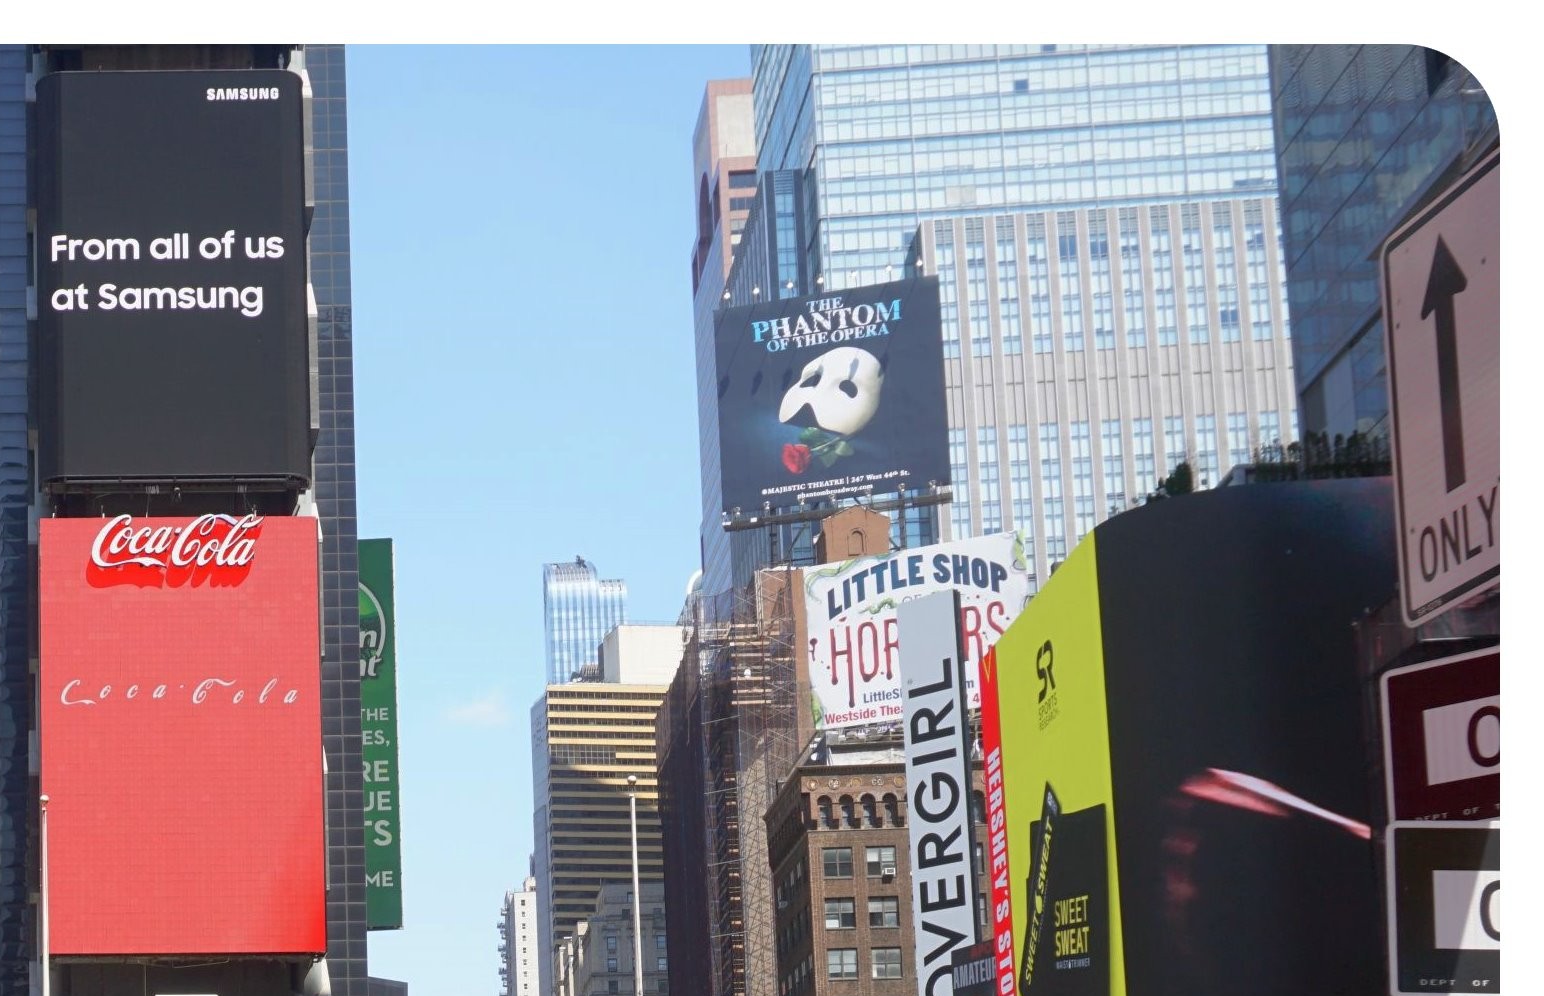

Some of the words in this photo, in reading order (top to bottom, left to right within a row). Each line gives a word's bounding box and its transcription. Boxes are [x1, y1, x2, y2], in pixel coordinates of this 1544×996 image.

[206, 87, 279, 101] SAMSUNG
[50, 234, 141, 262] From
[149, 232, 189, 260] all
[198, 229, 235, 260] of
[244, 235, 285, 259] us
[50, 282, 89, 311] at
[97, 282, 264, 318] Samsung
[806, 296, 844, 313] THE
[750, 299, 903, 343] PHANTOM
[766, 337, 791, 353] OF
[792, 331, 829, 349] THE
[830, 322, 890, 343] OPERA
[796, 483, 874, 500] phantombroadway.com
[807, 478, 845, 489] THEATRE
[90, 513, 265, 569] Coca-Cola
[1419, 486, 1500, 582] ONLY
[827, 554, 925, 621] LITTLE
[932, 553, 1008, 593] SHOP
[824, 709, 877, 725] Westside
[1038, 694, 1058, 722] SPORTS
[1462, 806, 1480, 817] OF
[986, 746, 1010, 925] HERSHEY'S
[1024, 914, 1041, 986] SWEET
[1038, 815, 1054, 892] SWEAT
[1054, 895, 1090, 928] SWEET
[1054, 926, 1090, 957] SWEAT
[1071, 957, 1091, 969] TRIMMER
[1419, 979, 1457, 987] DEPT
[1471, 979, 1490, 987] OF
